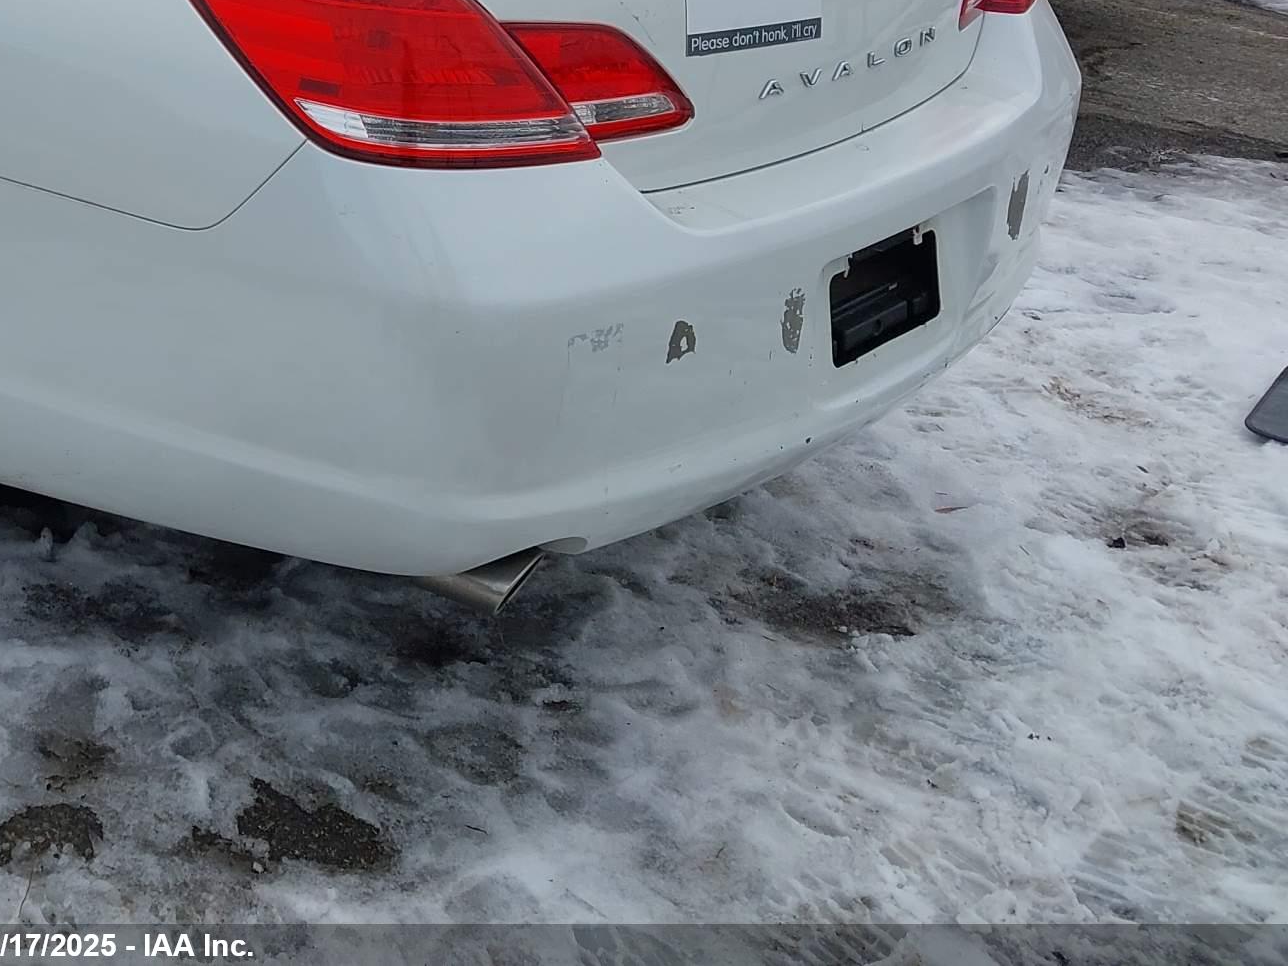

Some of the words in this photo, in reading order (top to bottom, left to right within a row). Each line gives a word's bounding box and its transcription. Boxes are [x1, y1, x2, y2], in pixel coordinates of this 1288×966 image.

[691, 35, 731, 52] Please
[732, 30, 761, 47] don't
[761, 25, 789, 43] honk,
[803, 24, 818, 38] cry
[758, 25, 937, 100] AVALON
